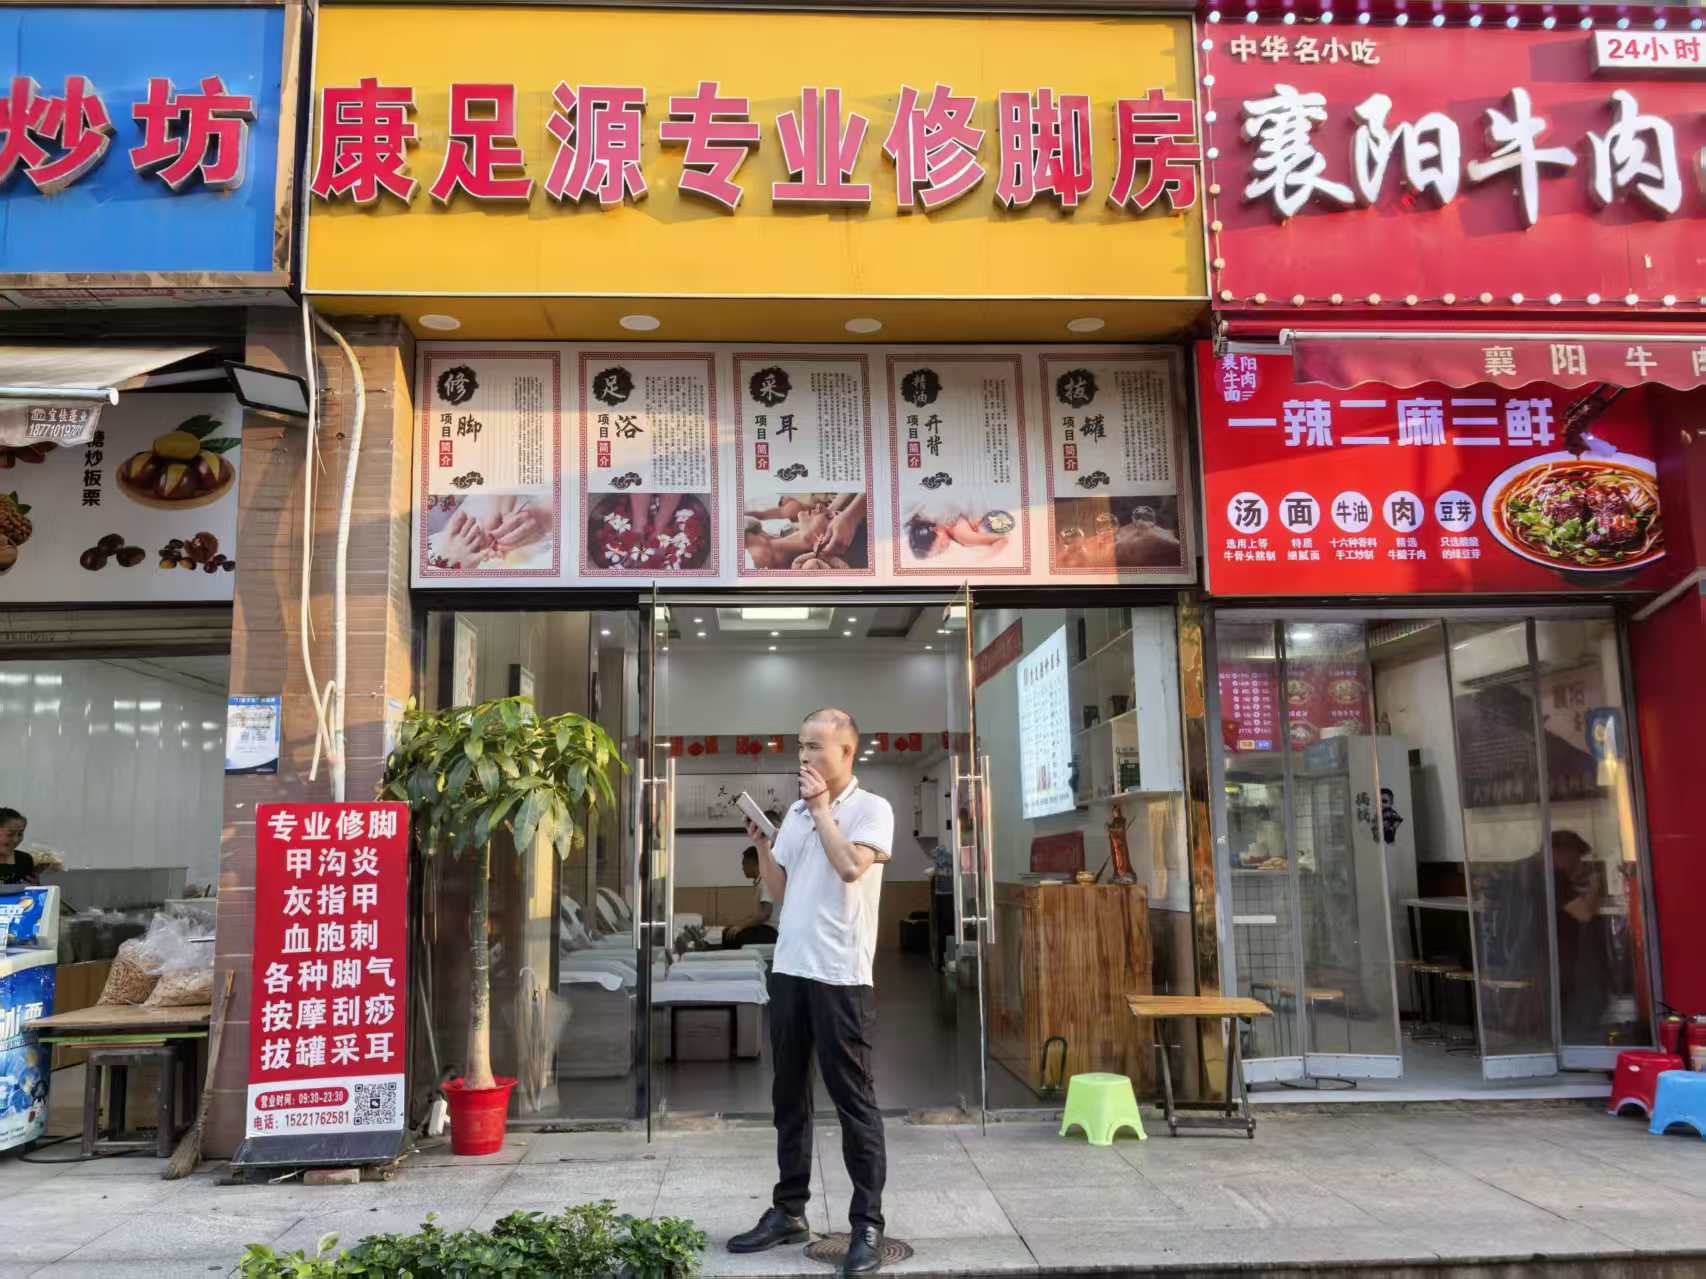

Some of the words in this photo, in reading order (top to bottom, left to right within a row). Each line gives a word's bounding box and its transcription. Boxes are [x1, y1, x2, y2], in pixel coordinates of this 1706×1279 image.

[1230, 35, 1380, 65] 中华名小吃
[1606, 35, 1701, 62] 24小时
[0, 75, 256, 193] 炒坊
[311, 77, 1201, 212] 康足源专业修脚房
[1242, 83, 1684, 231] 襄阳牛肉
[457, 413, 482, 443] 脚
[615, 414, 644, 439] 浴
[776, 414, 798, 443] 耳
[1228, 397, 1555, 447] 一辣二麻三鲜
[1234, 498, 1262, 527] 汤
[1285, 498, 1314, 527] 面
[1336, 500, 1369, 524] 牛油
[1391, 497, 1417, 527] 肉
[1440, 500, 1472, 521] 豆芽
[267, 809, 398, 842] 专业修脚
[287, 847, 380, 879] 甲沟炎
[282, 884, 379, 916] 灰指甲
[281, 920, 379, 954] 血胞刺
[264, 956, 396, 995] 各种脚气
[261, 993, 396, 1033] 按摩刮痧
[260, 1032, 395, 1072] 拔罐采耳
